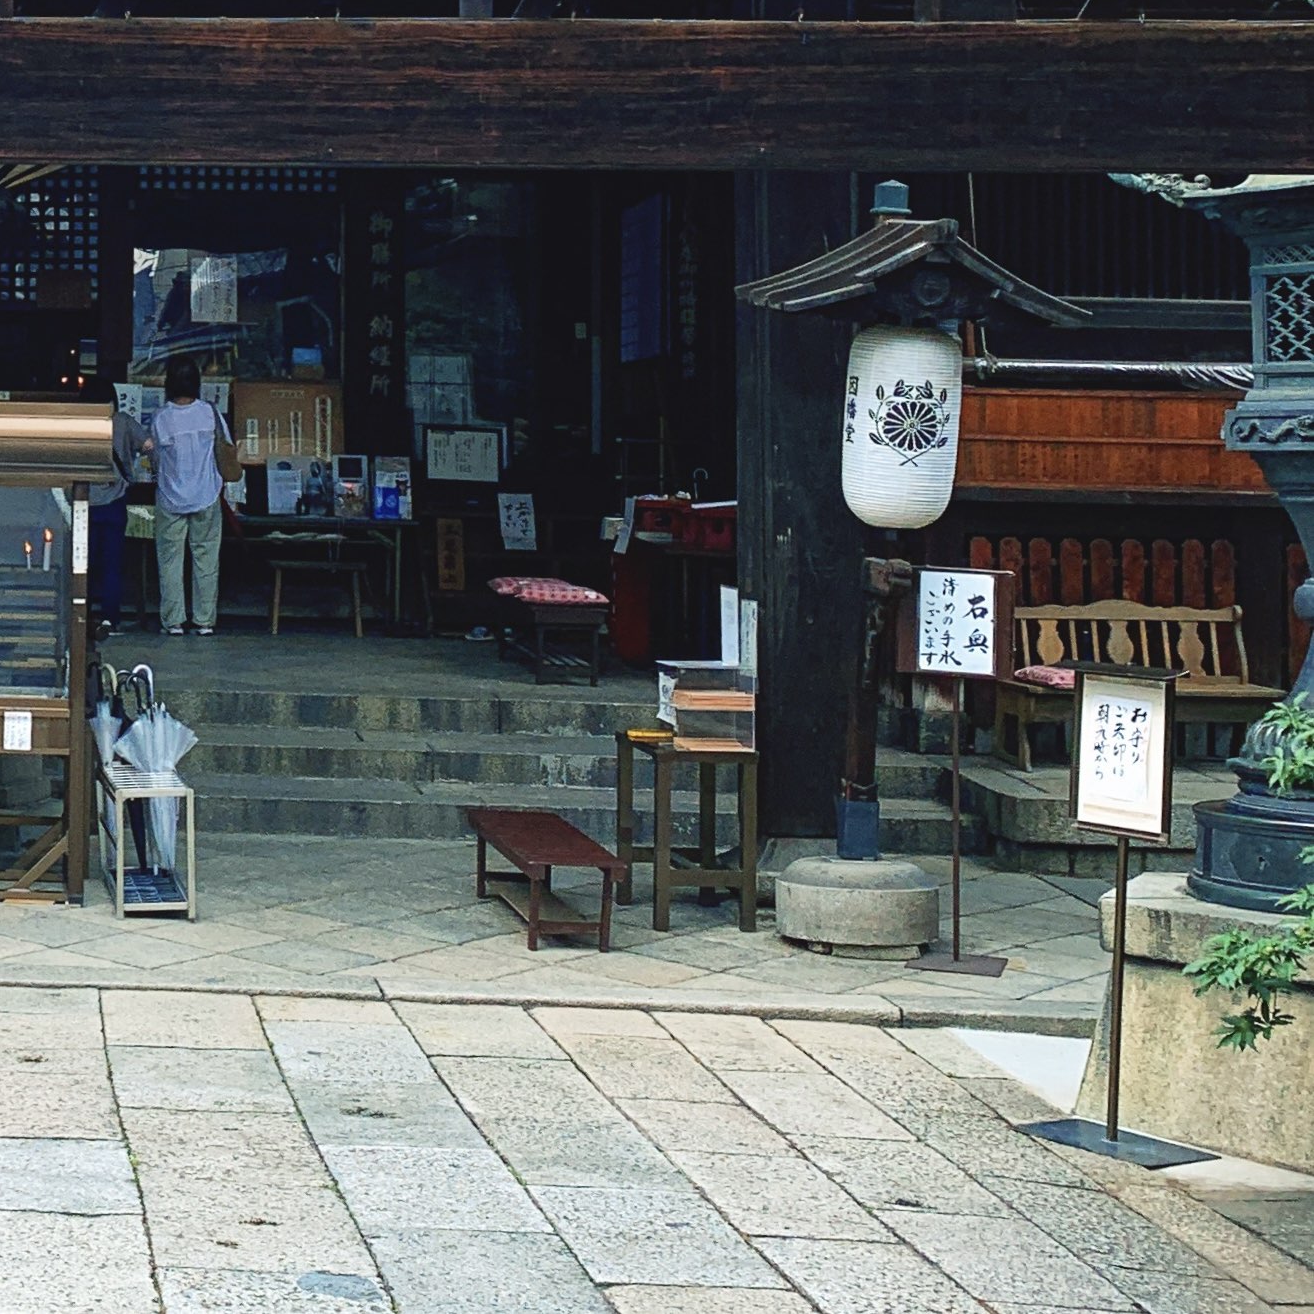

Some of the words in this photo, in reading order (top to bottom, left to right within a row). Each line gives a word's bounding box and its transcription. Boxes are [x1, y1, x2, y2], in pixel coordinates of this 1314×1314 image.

[921, 590, 941, 666] ございます
[1129, 707, 1148, 764] お守り
